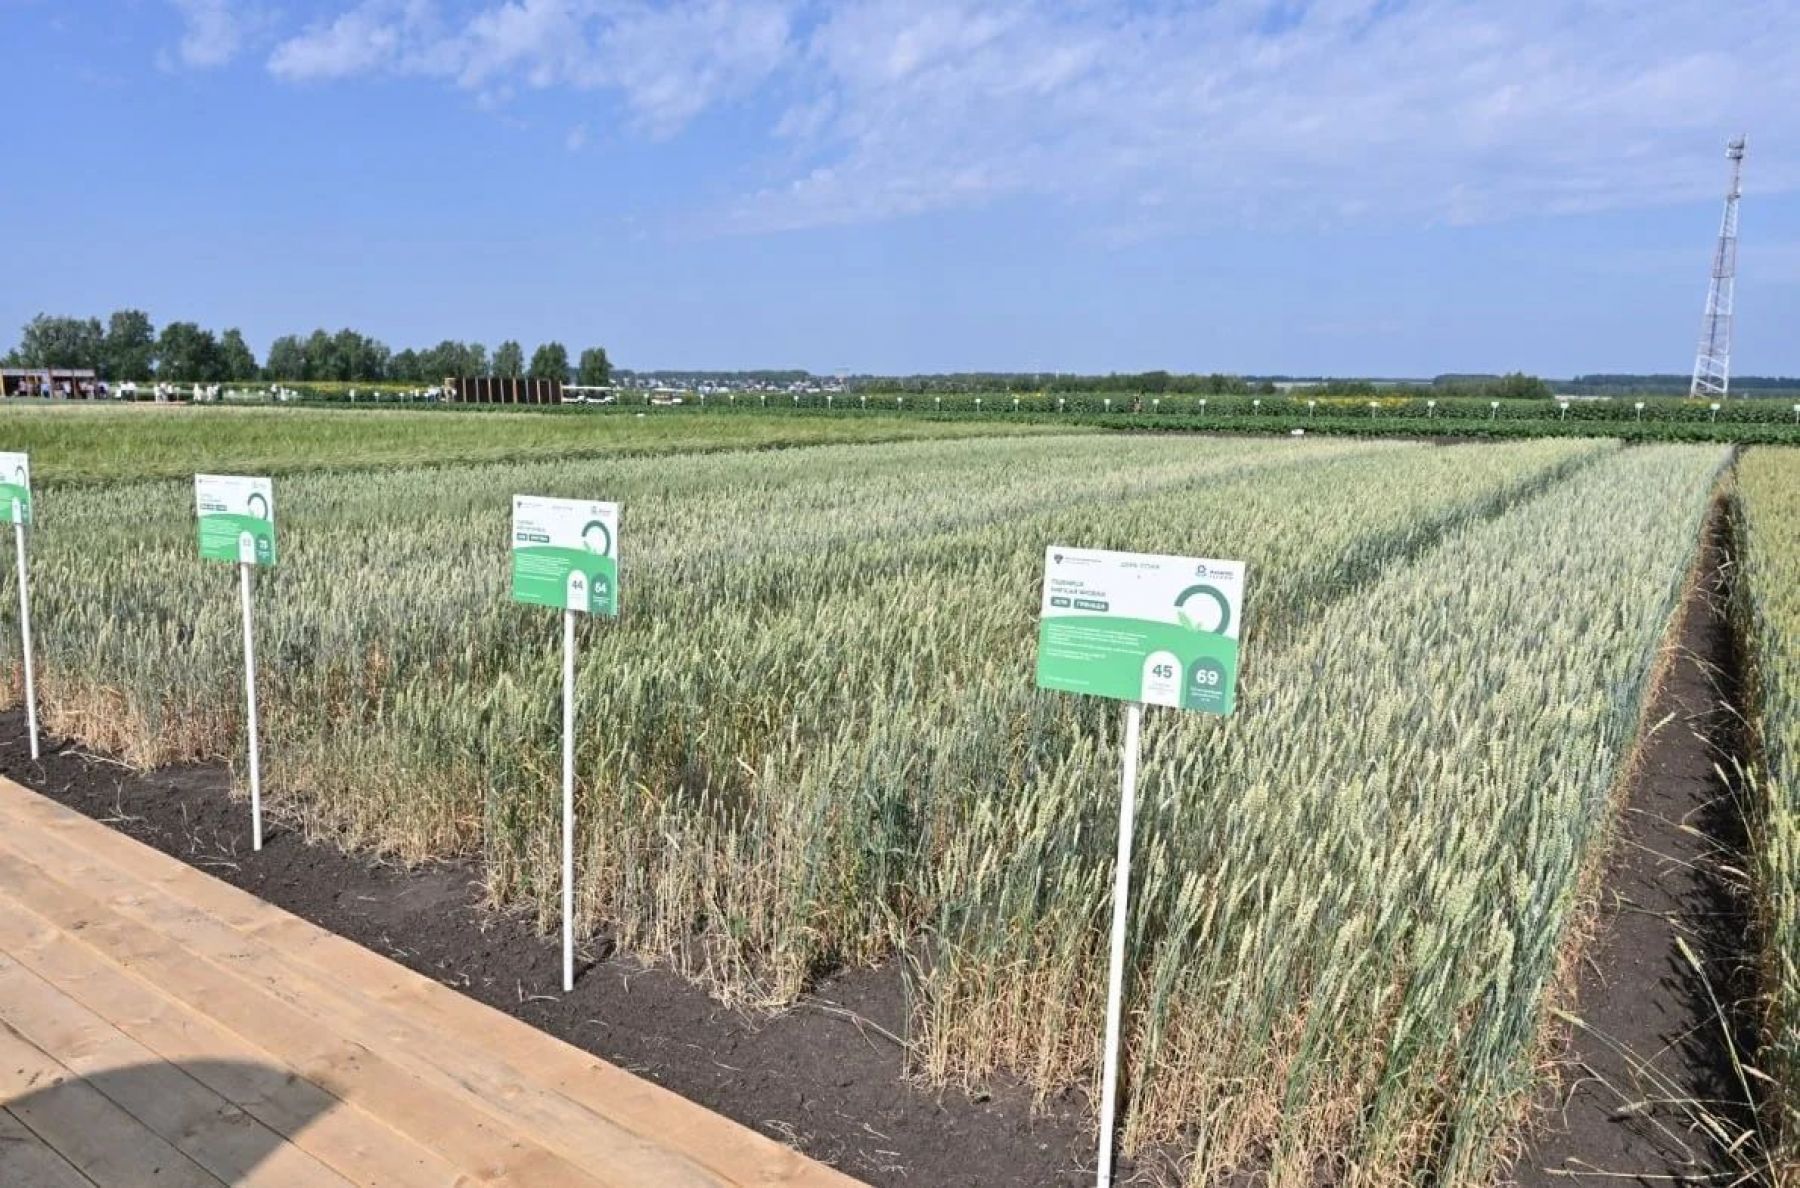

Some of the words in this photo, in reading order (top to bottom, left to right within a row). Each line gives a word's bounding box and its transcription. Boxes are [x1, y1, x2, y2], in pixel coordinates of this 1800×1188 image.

[571, 580, 584, 590] 44
[1152, 664, 1173, 679] 45
[1196, 669, 1219, 686] 69
